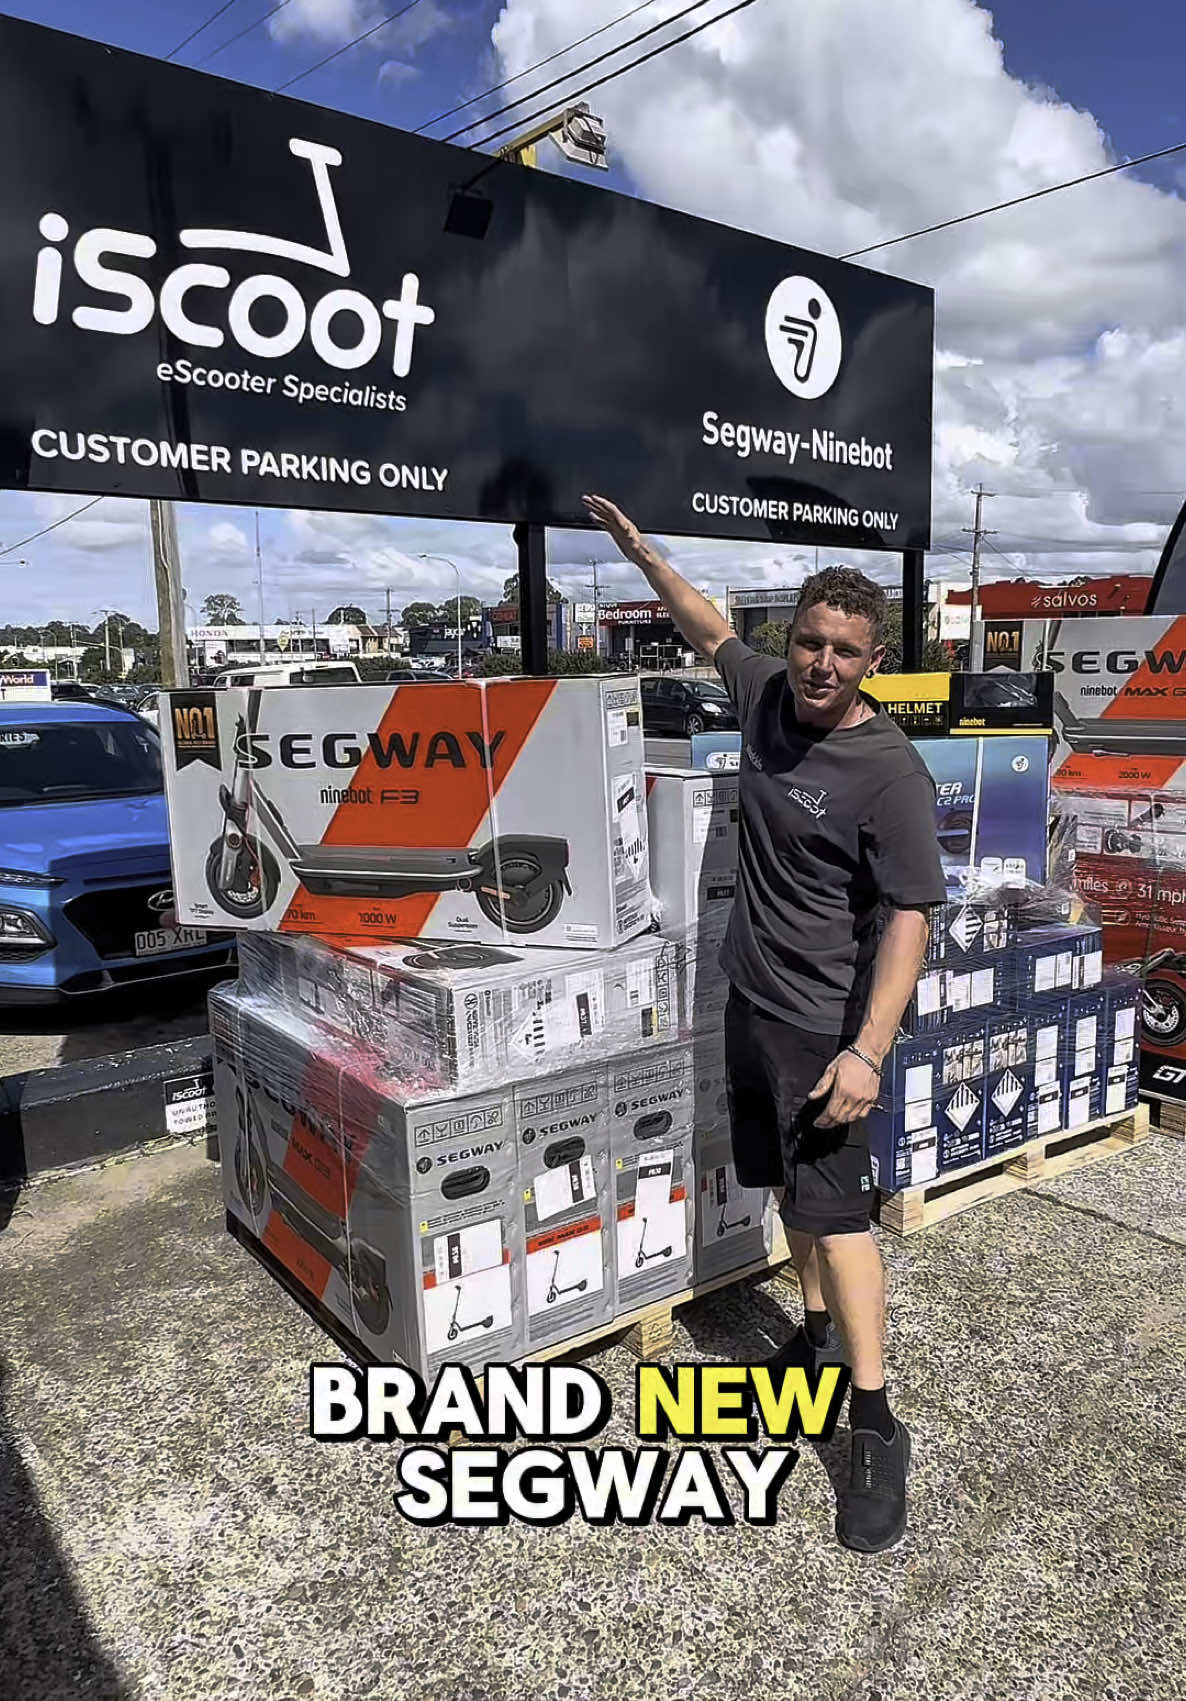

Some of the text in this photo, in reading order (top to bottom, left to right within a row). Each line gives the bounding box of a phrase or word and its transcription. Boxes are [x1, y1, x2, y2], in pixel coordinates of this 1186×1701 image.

[156, 359, 408, 412] eScooter Specialists
[702, 411, 893, 470] Segway-Ninebot
[31, 428, 449, 491] CUSTOMER PARKING ONLY
[692, 492, 899, 531] CUSTOMER PARKING ONLY
[1043, 591, 1097, 608] salvos
[191, 629, 229, 638] HONDA
[1080, 685, 1118, 697] ninebot
[1124, 687, 1169, 697] MAX
[887, 702, 944, 714] HELMET
[237, 731, 507, 769] SEGWAY
[320, 785, 420, 804] ninebot F3
[1137, 883, 1153, 900] 31
[299, 908, 317, 921] km
[359, 911, 397, 925] 1000 W
[631, 1087, 685, 1111] SEGWAY
[539, 1111, 597, 1137] SEGWAY
[436, 1140, 504, 1167] SEGWAY
